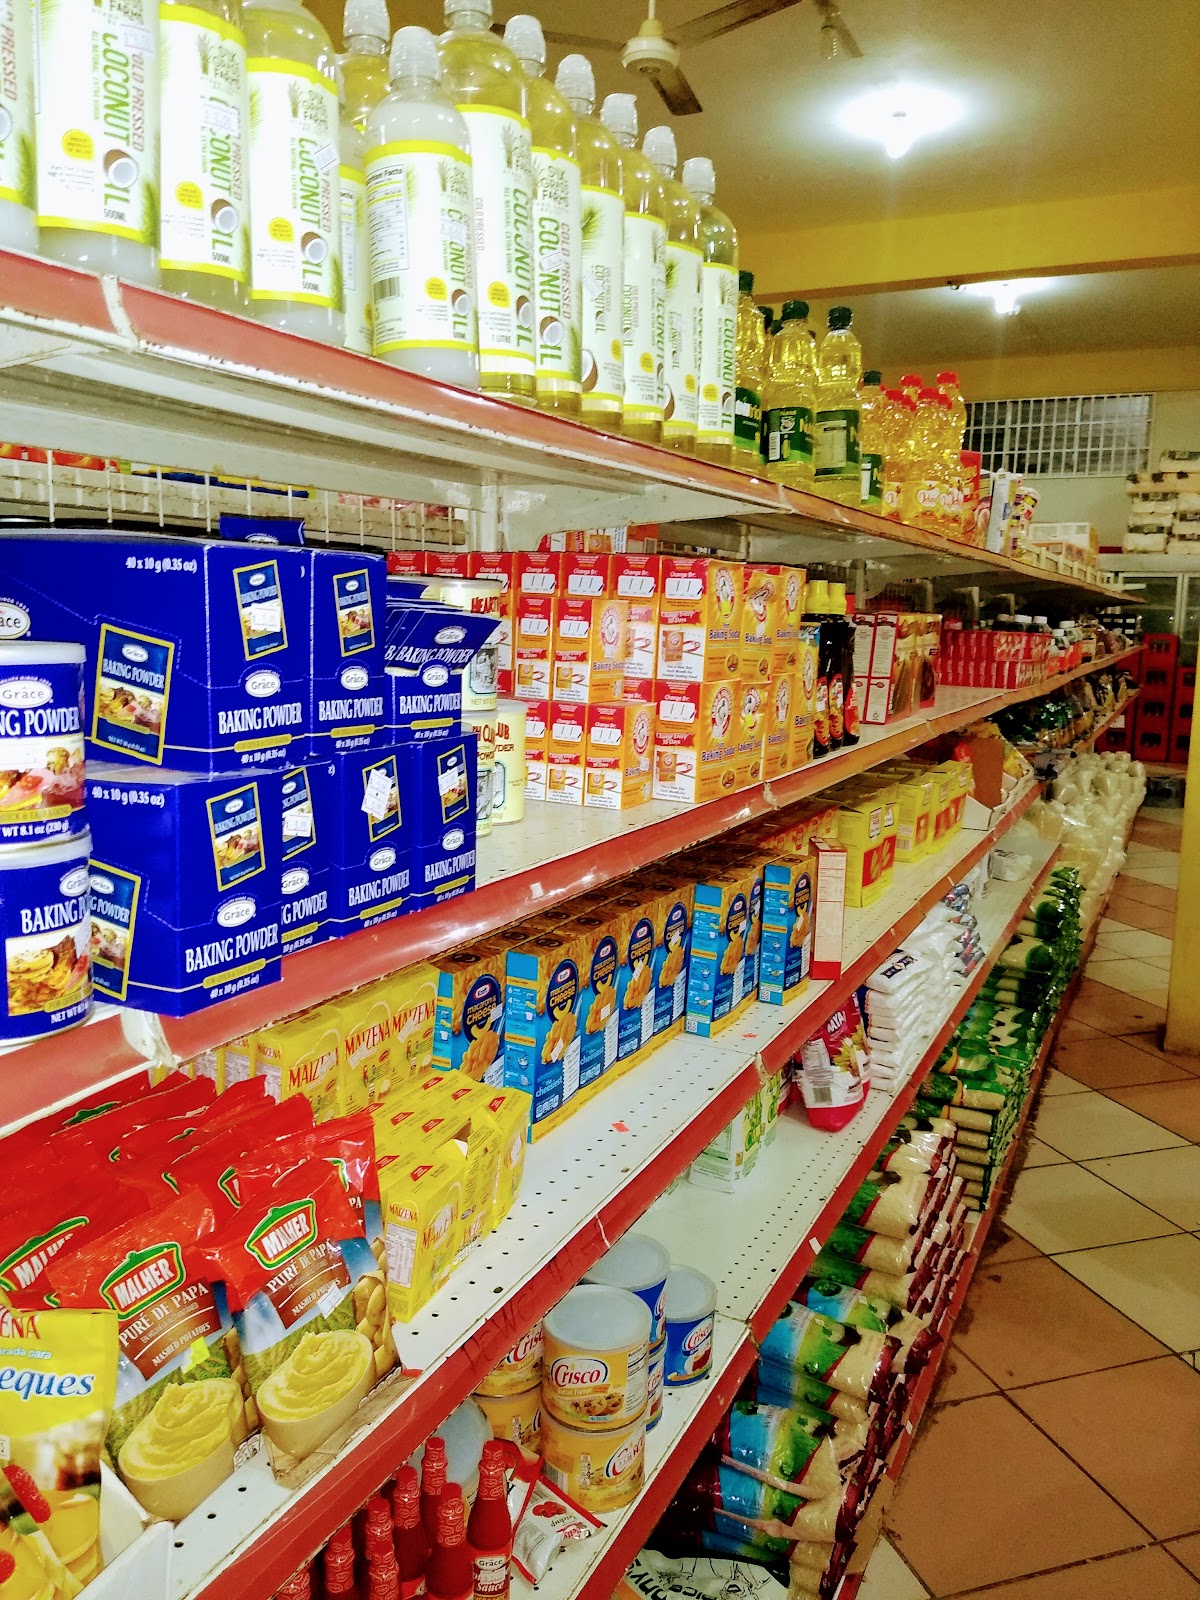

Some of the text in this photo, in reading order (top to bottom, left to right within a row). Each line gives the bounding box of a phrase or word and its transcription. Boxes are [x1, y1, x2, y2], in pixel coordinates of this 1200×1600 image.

[132, 86, 144, 152] PRESSED
[562, 261, 573, 319] PRESSED
[125, 556, 136, 570] 40
[144, 557, 154, 570] 10
[0, 617, 21, 629] ace
[103, 658, 165, 690] BAKING POWDER
[250, 680, 276, 691] Grace
[344, 674, 365, 685] Grace
[2, 689, 45, 700] Grace
[399, 691, 462, 715] BAKING POWDER
[24, 706, 80, 736] POWDER
[218, 702, 303, 735] BAKING POWDER
[318, 696, 384, 722] BAKING POWDER
[92, 786, 102, 800] 40
[110, 788, 121, 801] 10
[121, 791, 129, 806] g
[129, 790, 149, 806] (0.35
[150, 793, 165, 808] oz)
[2, 826, 19, 838] WT
[373, 854, 392, 867] Grace
[424, 858, 451, 883] BAKING
[348, 879, 382, 907] BAKING
[381, 868, 410, 896] POWDER
[20, 897, 78, 935] BAKING
[98, 897, 131, 924] POWDER
[222, 907, 252, 922] Grace
[292, 890, 328, 921] POWDER
[185, 936, 234, 974] BAKING
[234, 922, 279, 960] POWDER
[392, 998, 436, 1034] MAIZENA
[256, 1041, 281, 1059] MAIZENA
[344, 1018, 391, 1060] MAIZENA
[389, 1203, 418, 1223] MAIZENA
[262, 1212, 311, 1260] MALHER
[300, 1253, 310, 1269] DE
[309, 1239, 334, 1263] PAPA
[113, 1257, 175, 1309] MALHER
[119, 1282, 210, 1348] PURÉ DE PAPA
[292, 1292, 317, 1316] MASHED
[687, 1321, 713, 1349] Crisco
[29, 1349, 52, 1360] para
[152, 1340, 180, 1367] MASHED
[0, 1367, 95, 1400] eques
[553, 1364, 602, 1388] Crisco
[478, 1557, 503, 1567] Grace
[476, 1580, 505, 1592] Sauce
